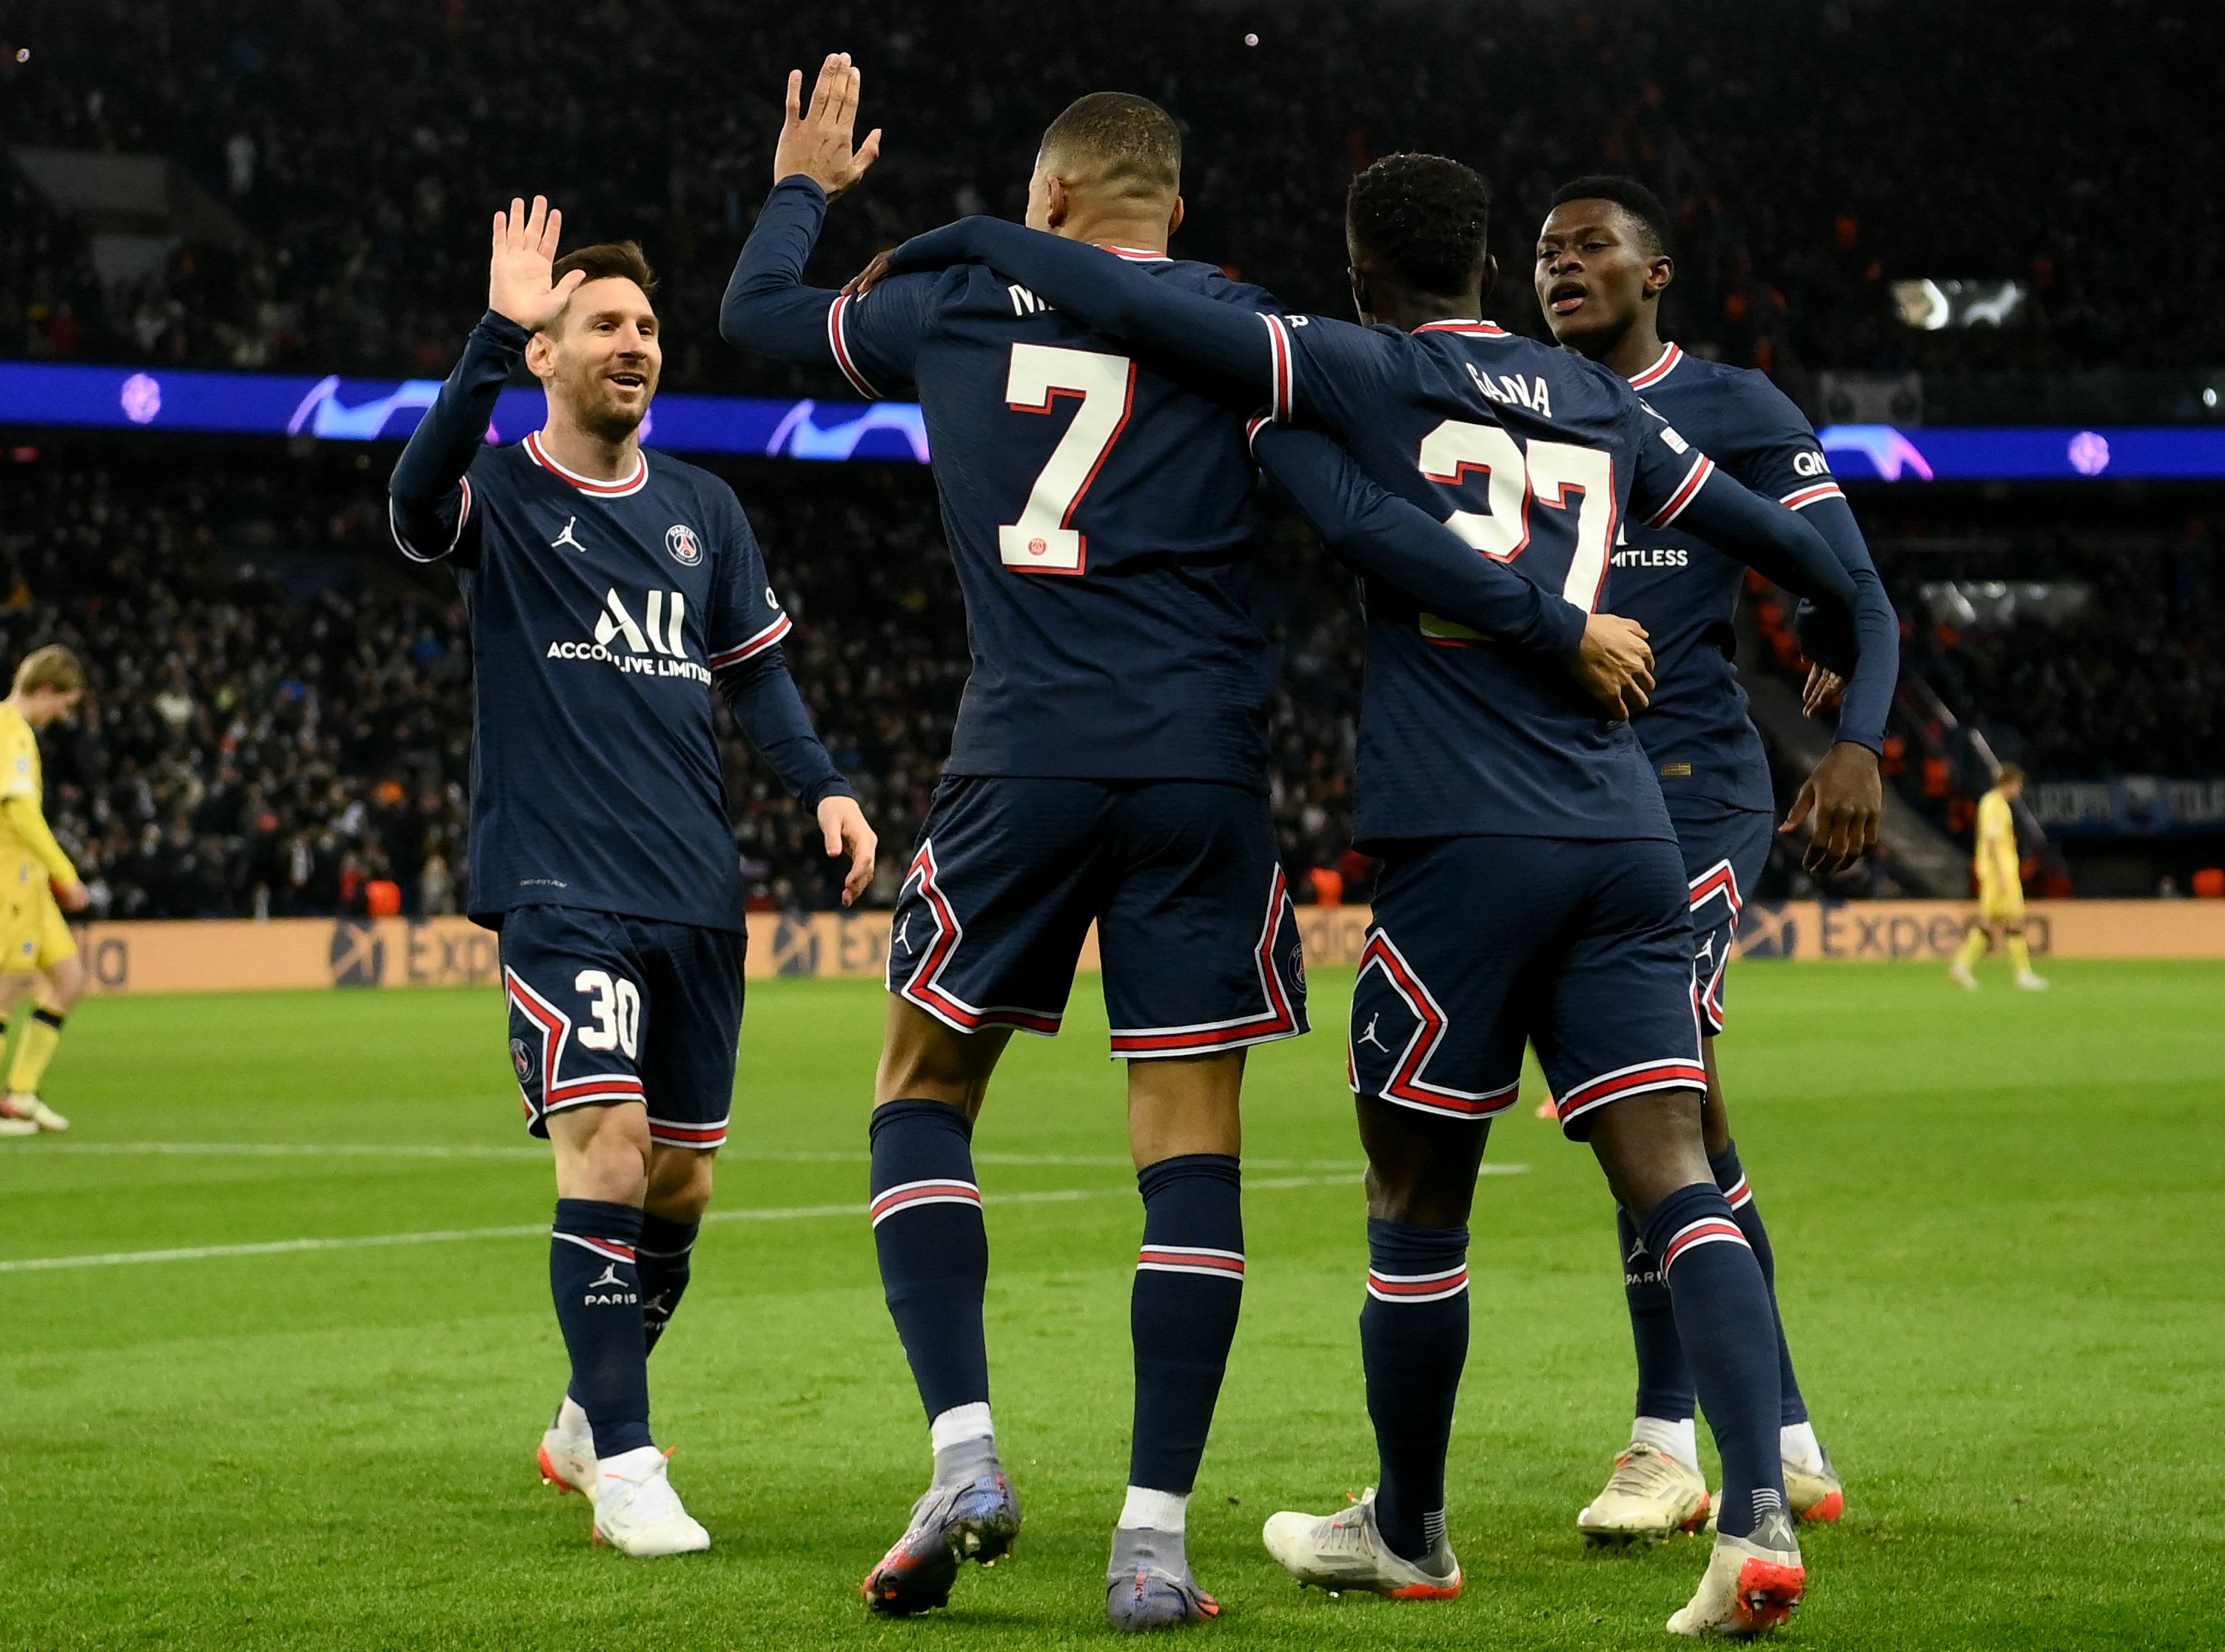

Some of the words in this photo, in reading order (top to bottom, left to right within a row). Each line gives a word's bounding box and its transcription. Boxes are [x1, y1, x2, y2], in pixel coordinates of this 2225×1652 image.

[1466, 362, 1552, 418] GANA
[999, 342, 1137, 576] 7
[1821, 901, 2052, 956] Expea
[574, 970, 640, 1059] 30
[584, 1293, 637, 1306] PARIS
[1626, 1270, 1667, 1286] PARI
